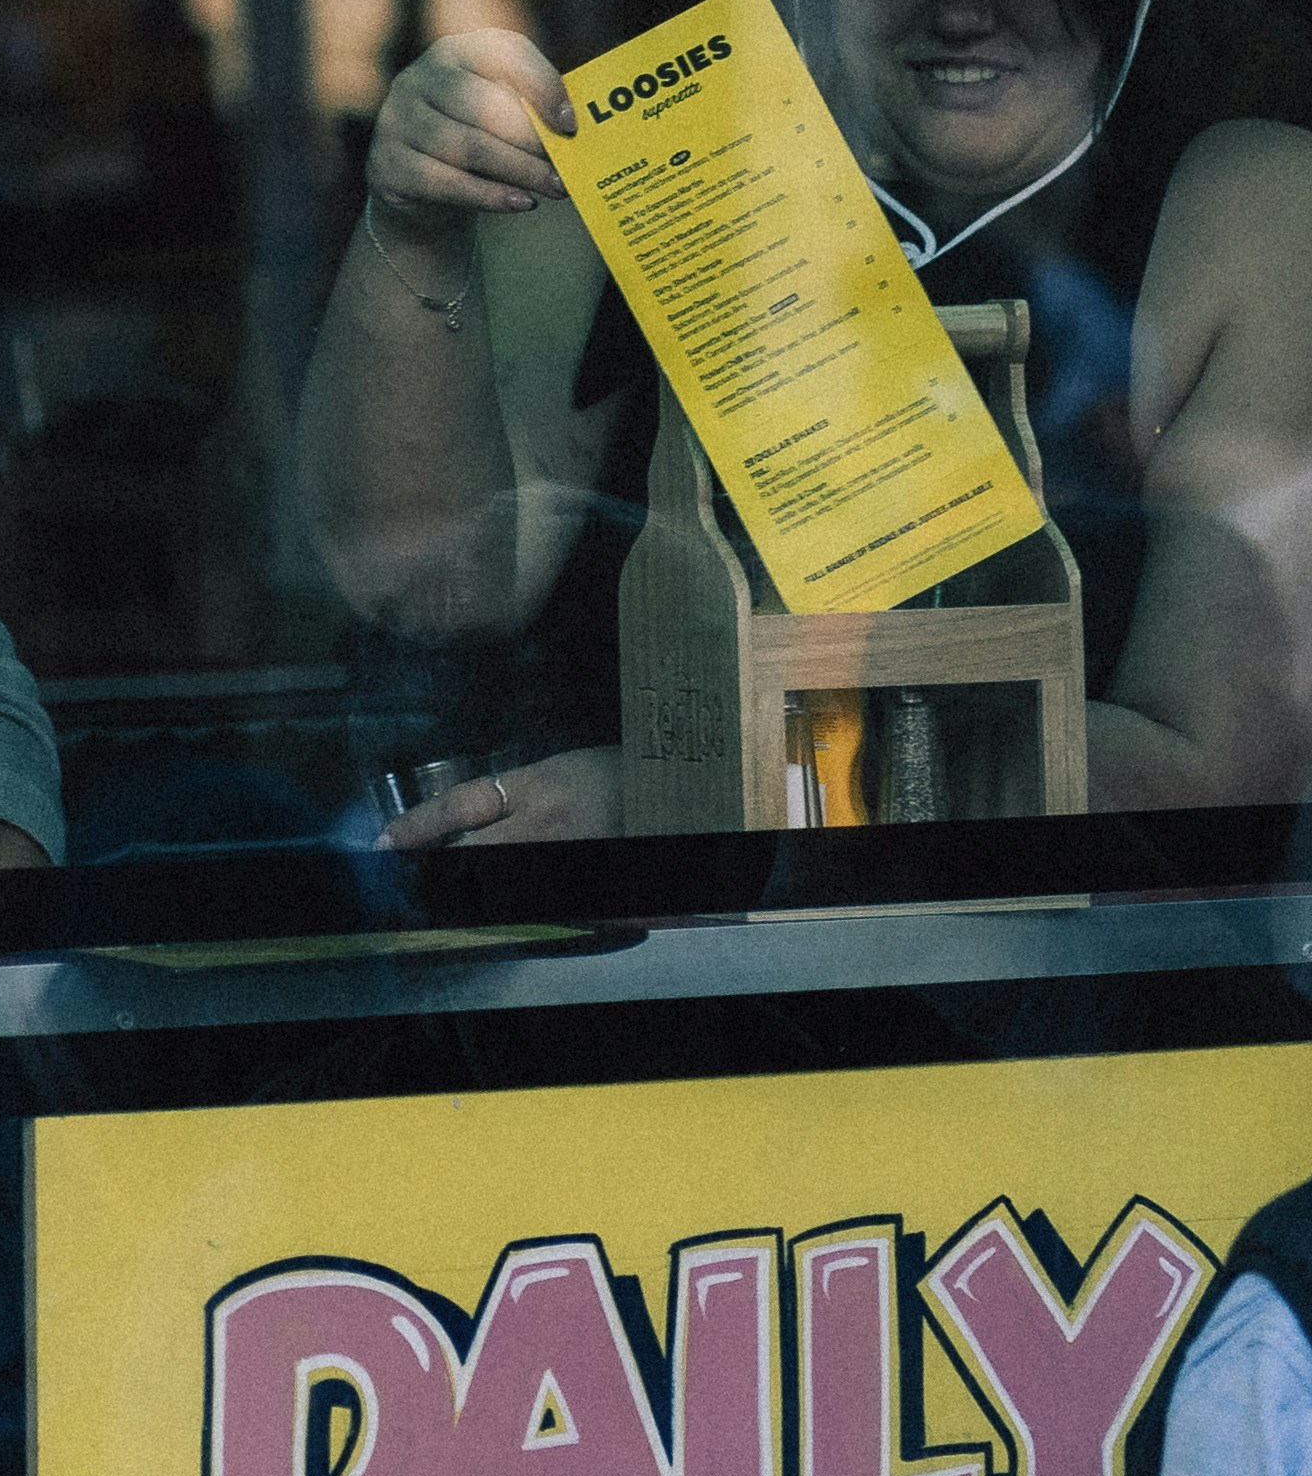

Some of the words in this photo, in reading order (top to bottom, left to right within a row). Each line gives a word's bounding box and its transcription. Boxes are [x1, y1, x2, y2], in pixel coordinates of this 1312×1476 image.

[583, 30, 736, 126] LOOSIES
[636, 78, 706, 126] superette
[594, 156, 650, 191] COCKTAILS
